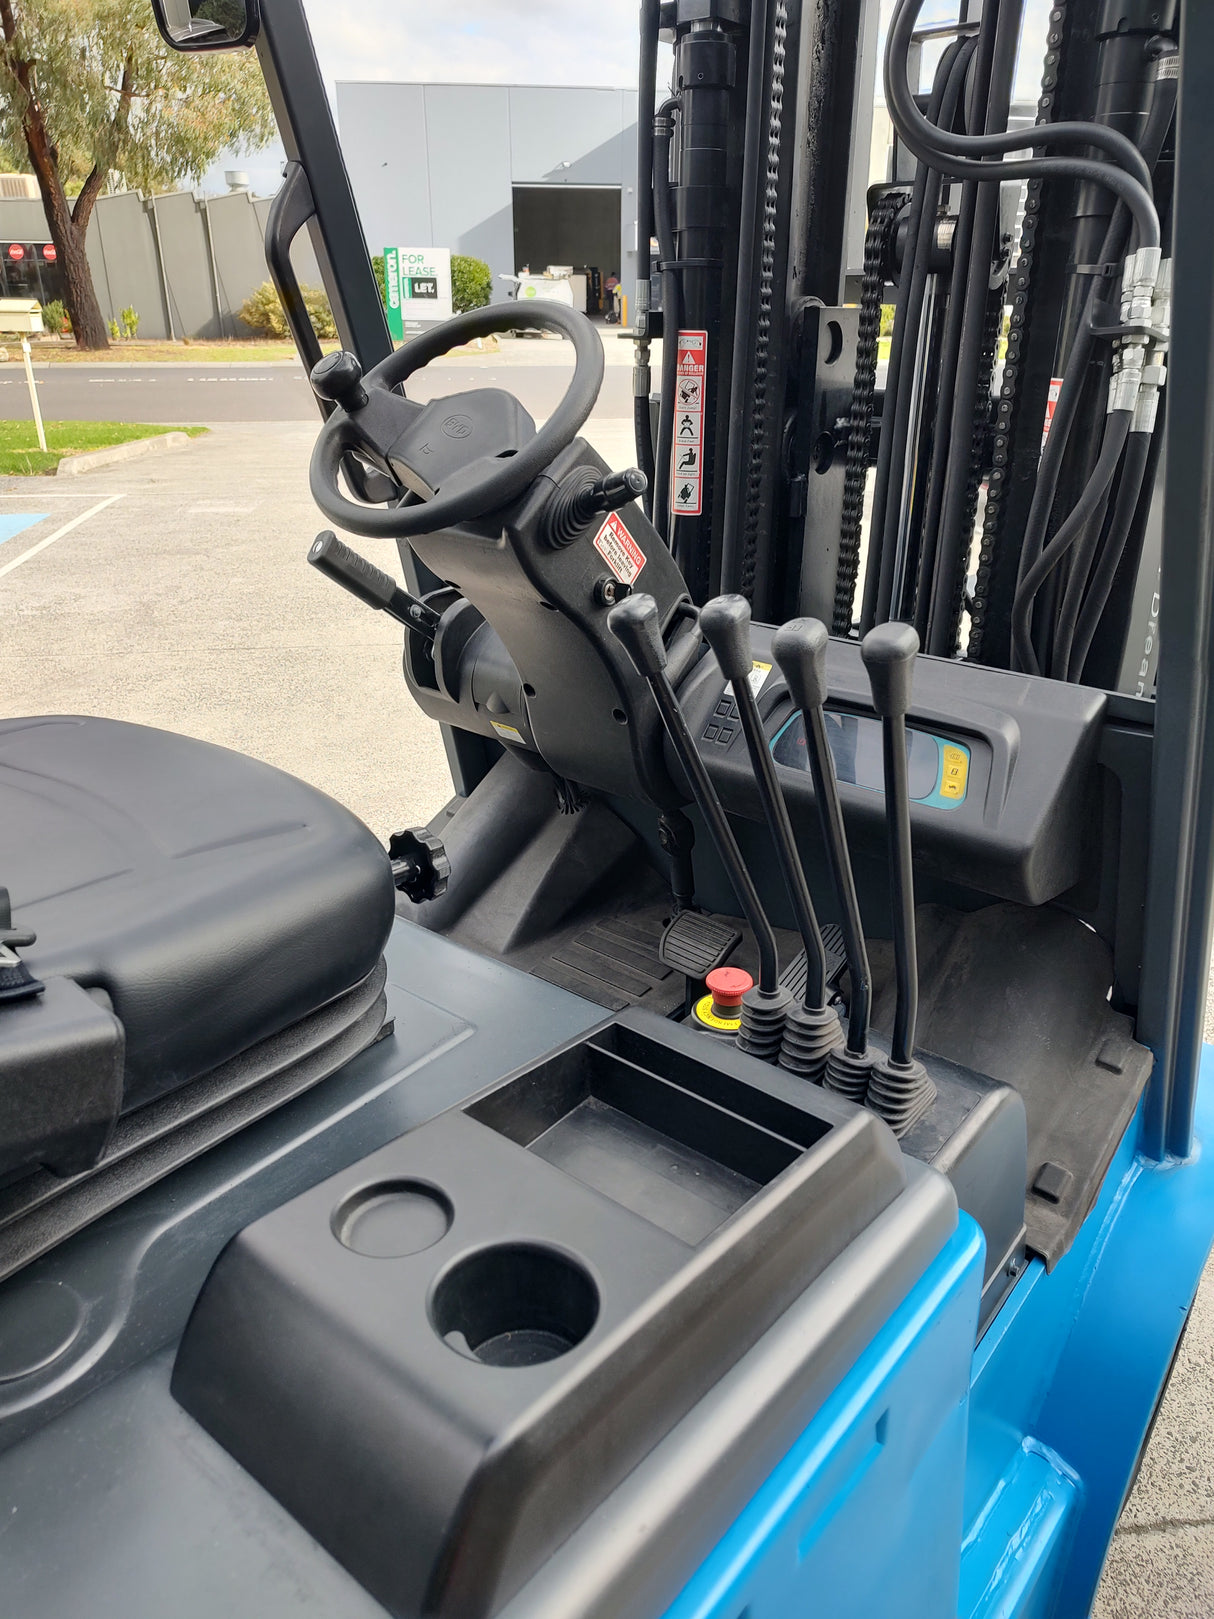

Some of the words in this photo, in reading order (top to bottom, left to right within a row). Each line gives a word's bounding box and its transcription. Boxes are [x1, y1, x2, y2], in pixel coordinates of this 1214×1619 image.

[402, 254, 425, 265] FOR
[603, 534, 618, 556] before
[618, 554, 633, 578] leaving
[607, 550, 623, 573] Forklift
[609, 531, 626, 556] Remove
[625, 555, 634, 569] Key
[616, 528, 642, 565] WARNING
